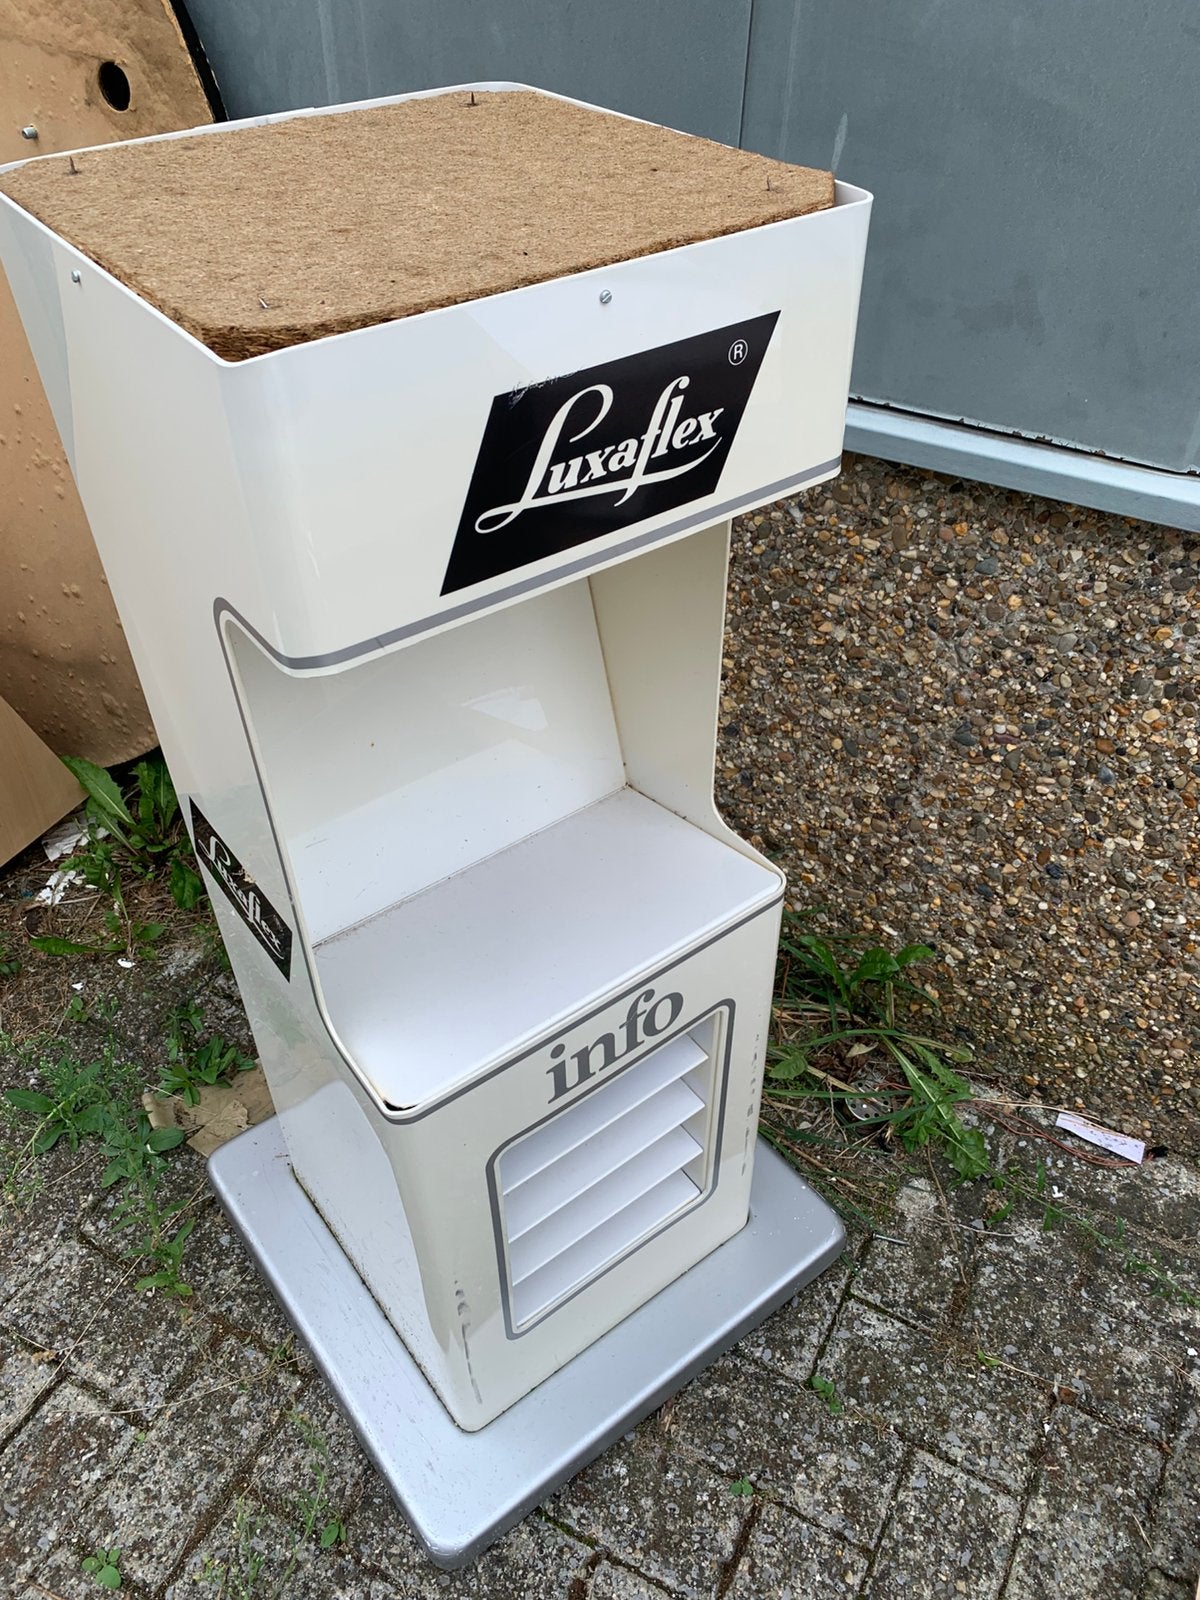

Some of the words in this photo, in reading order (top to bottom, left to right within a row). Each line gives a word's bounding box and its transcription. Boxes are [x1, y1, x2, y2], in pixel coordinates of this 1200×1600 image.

[474, 375, 725, 534] Luxaflex
[197, 835, 285, 960] Luxaflex
[545, 988, 684, 1105] info
